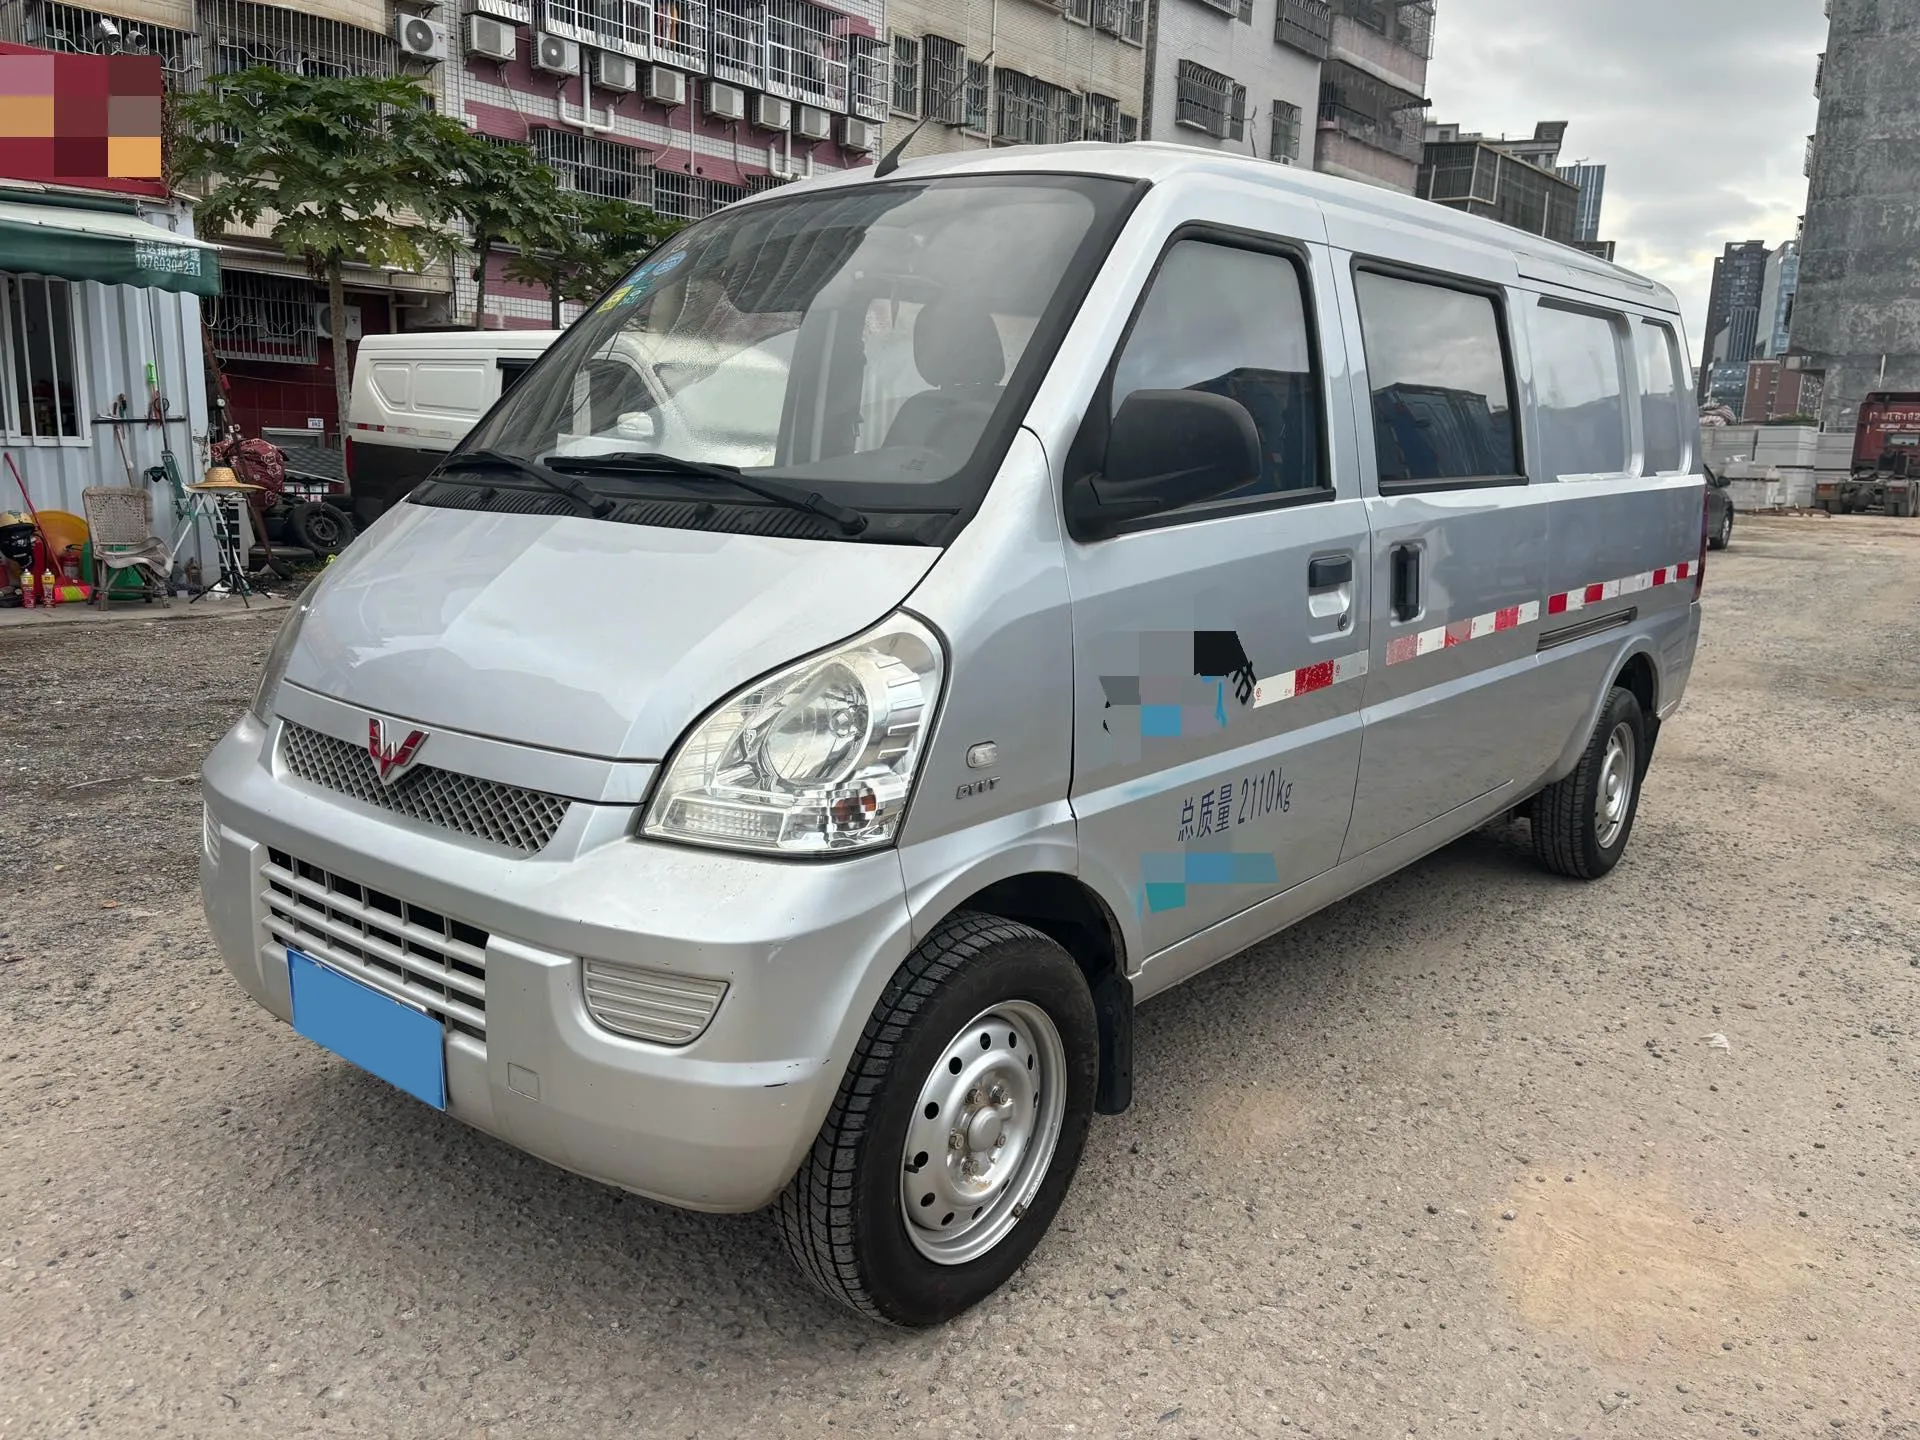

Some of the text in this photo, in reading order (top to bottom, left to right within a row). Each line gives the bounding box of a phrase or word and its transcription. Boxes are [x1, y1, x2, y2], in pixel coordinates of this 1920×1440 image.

[1178, 767, 1293, 841] 总质量 2110kg
